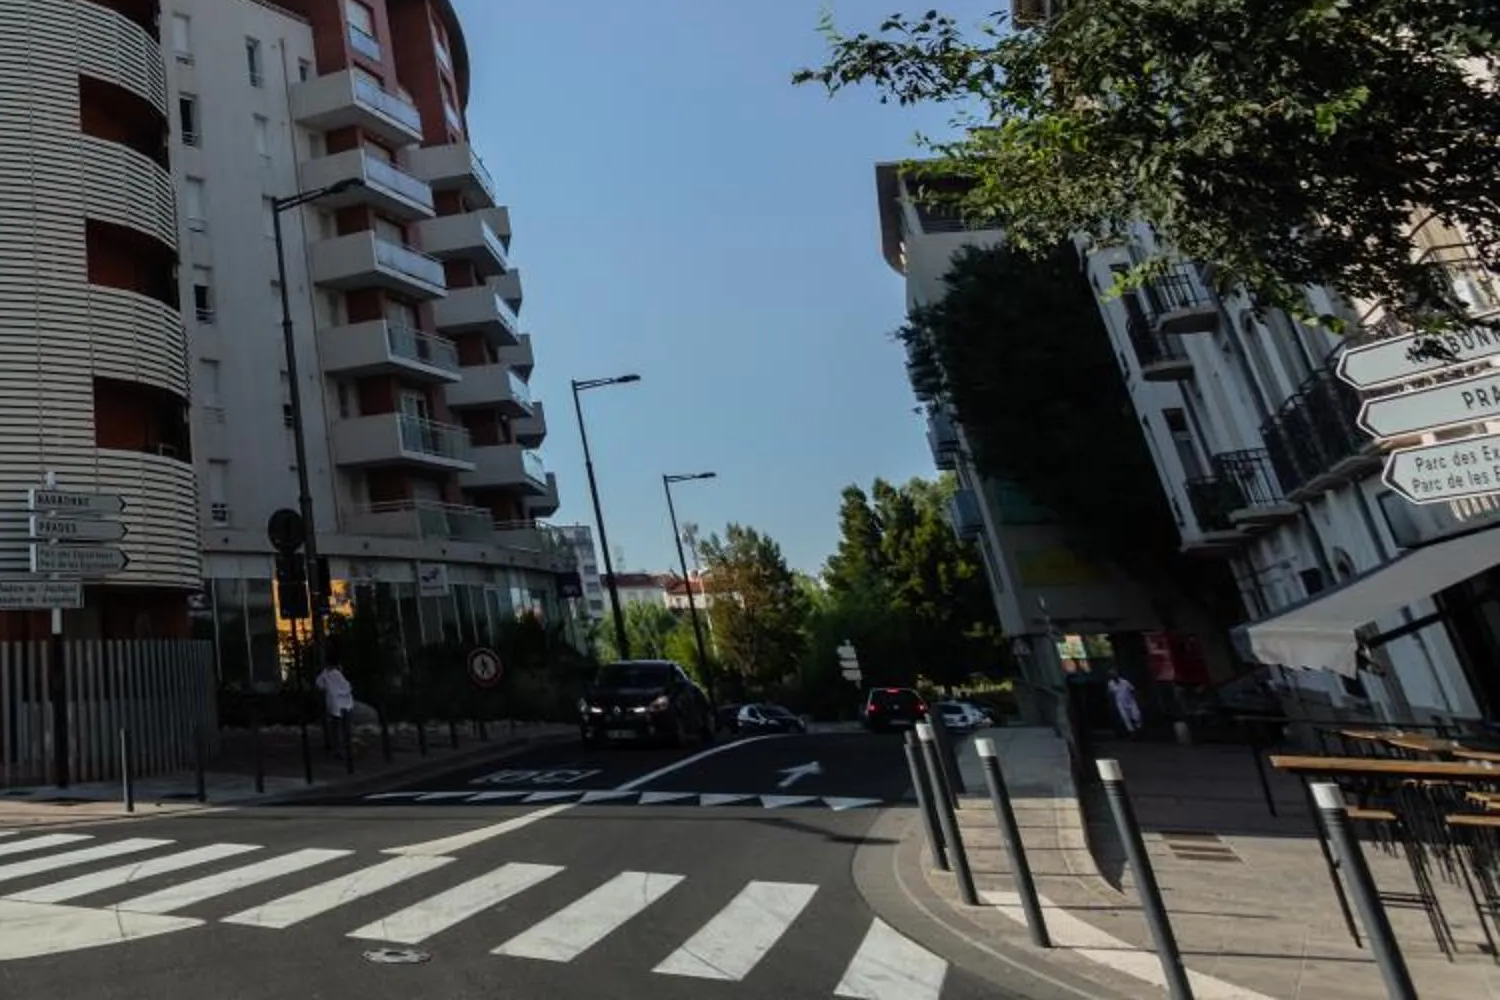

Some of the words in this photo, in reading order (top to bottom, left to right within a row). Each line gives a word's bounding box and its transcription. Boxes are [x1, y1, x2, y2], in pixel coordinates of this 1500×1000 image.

[1415, 457, 1447, 473] Parc
[1452, 450, 1477, 467] des
[1411, 477, 1443, 494] Parc
[1447, 473, 1465, 489] de
[1467, 470, 1490, 486] les
